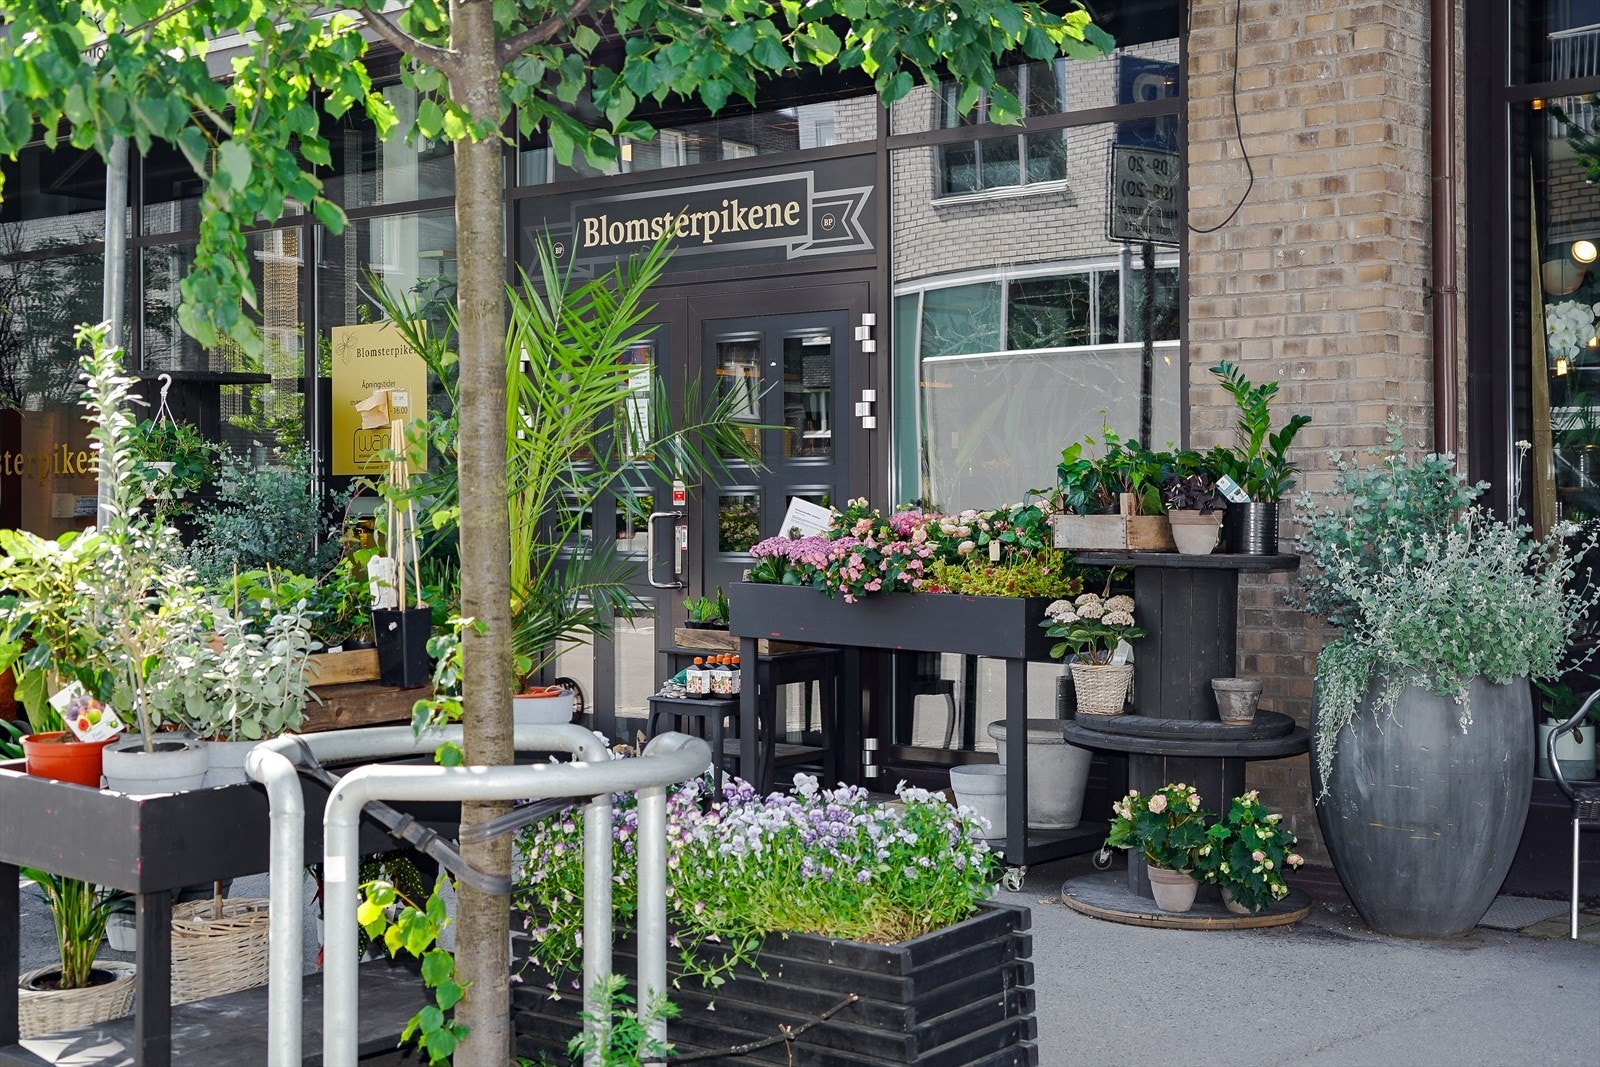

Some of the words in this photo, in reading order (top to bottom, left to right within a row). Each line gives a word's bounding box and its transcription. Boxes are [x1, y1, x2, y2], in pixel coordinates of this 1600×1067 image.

[583, 198, 800, 248] Blomsterpikene
[361, 379, 396, 390] Åpningstider
[358, 434, 392, 452] wan
